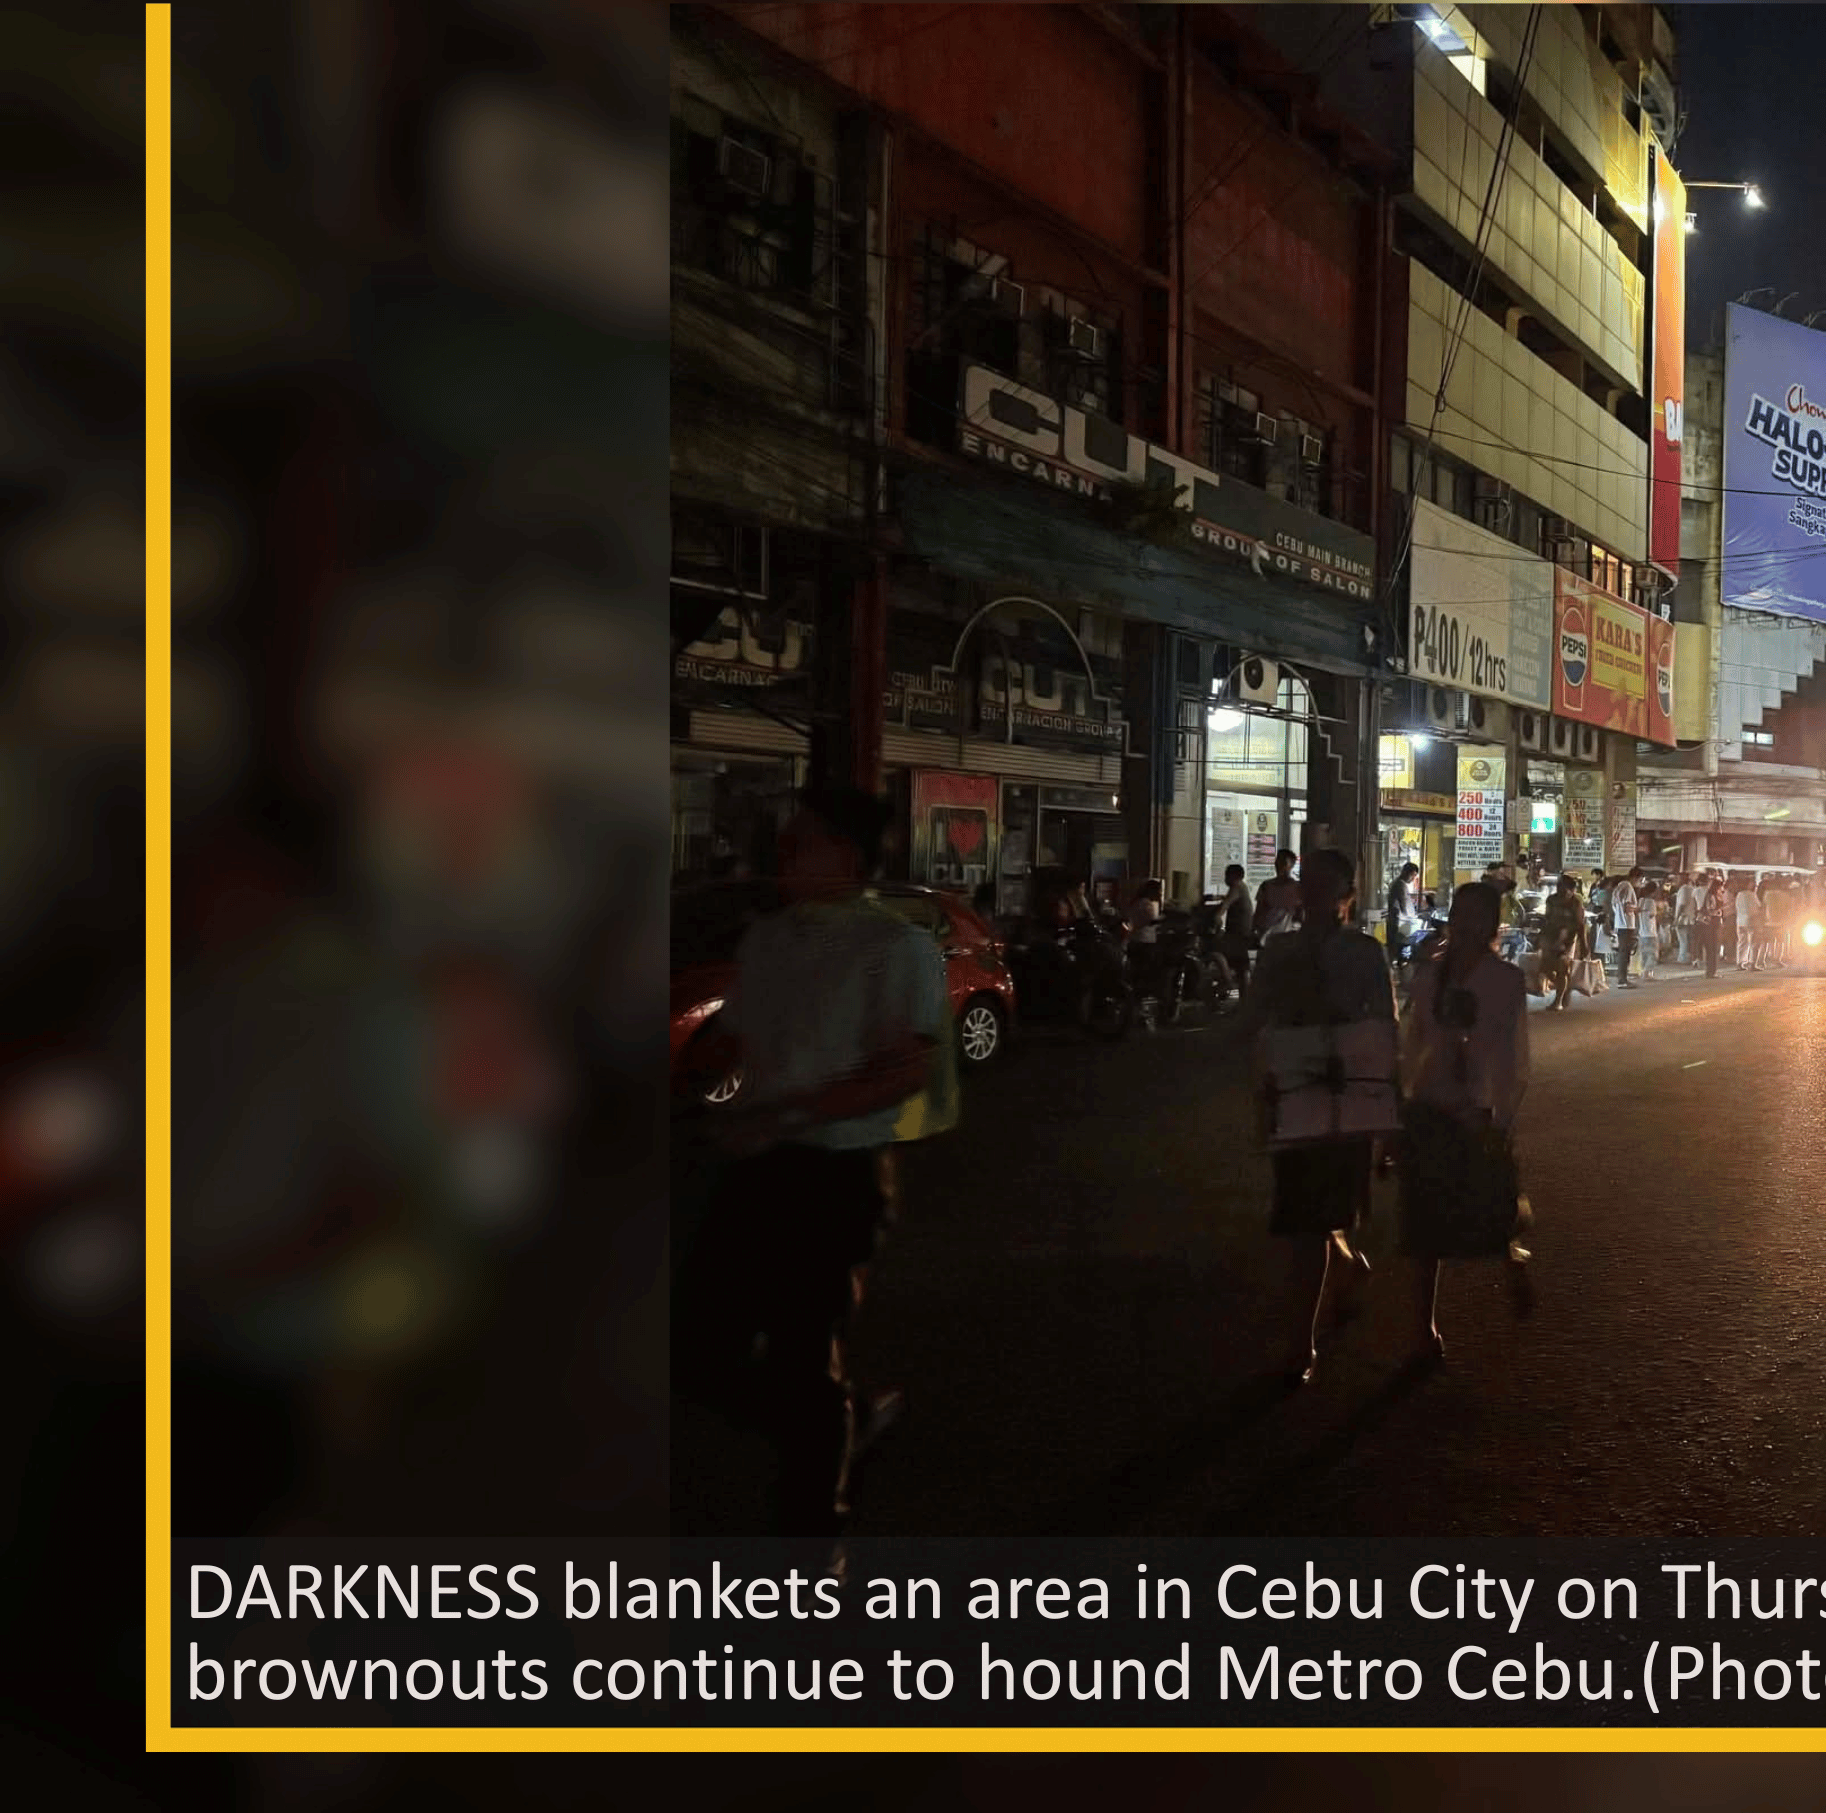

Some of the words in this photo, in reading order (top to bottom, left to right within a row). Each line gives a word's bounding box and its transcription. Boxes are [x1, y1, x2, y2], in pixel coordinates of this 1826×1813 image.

[965, 364, 1220, 513] CUT
[1190, 523, 1253, 557] GROU
[1275, 555, 1302, 574] OF
[1310, 567, 1371, 600] SALON
[1275, 532, 1304, 555] CEBU
[1307, 544, 1331, 565] MAIN
[1335, 555, 1371, 578] BRANCH
[1562, 635, 1587, 659] PEPSI
[1459, 791, 1483, 804] 250
[1458, 808, 1483, 821] 400
[1458, 823, 1483, 837] 800
